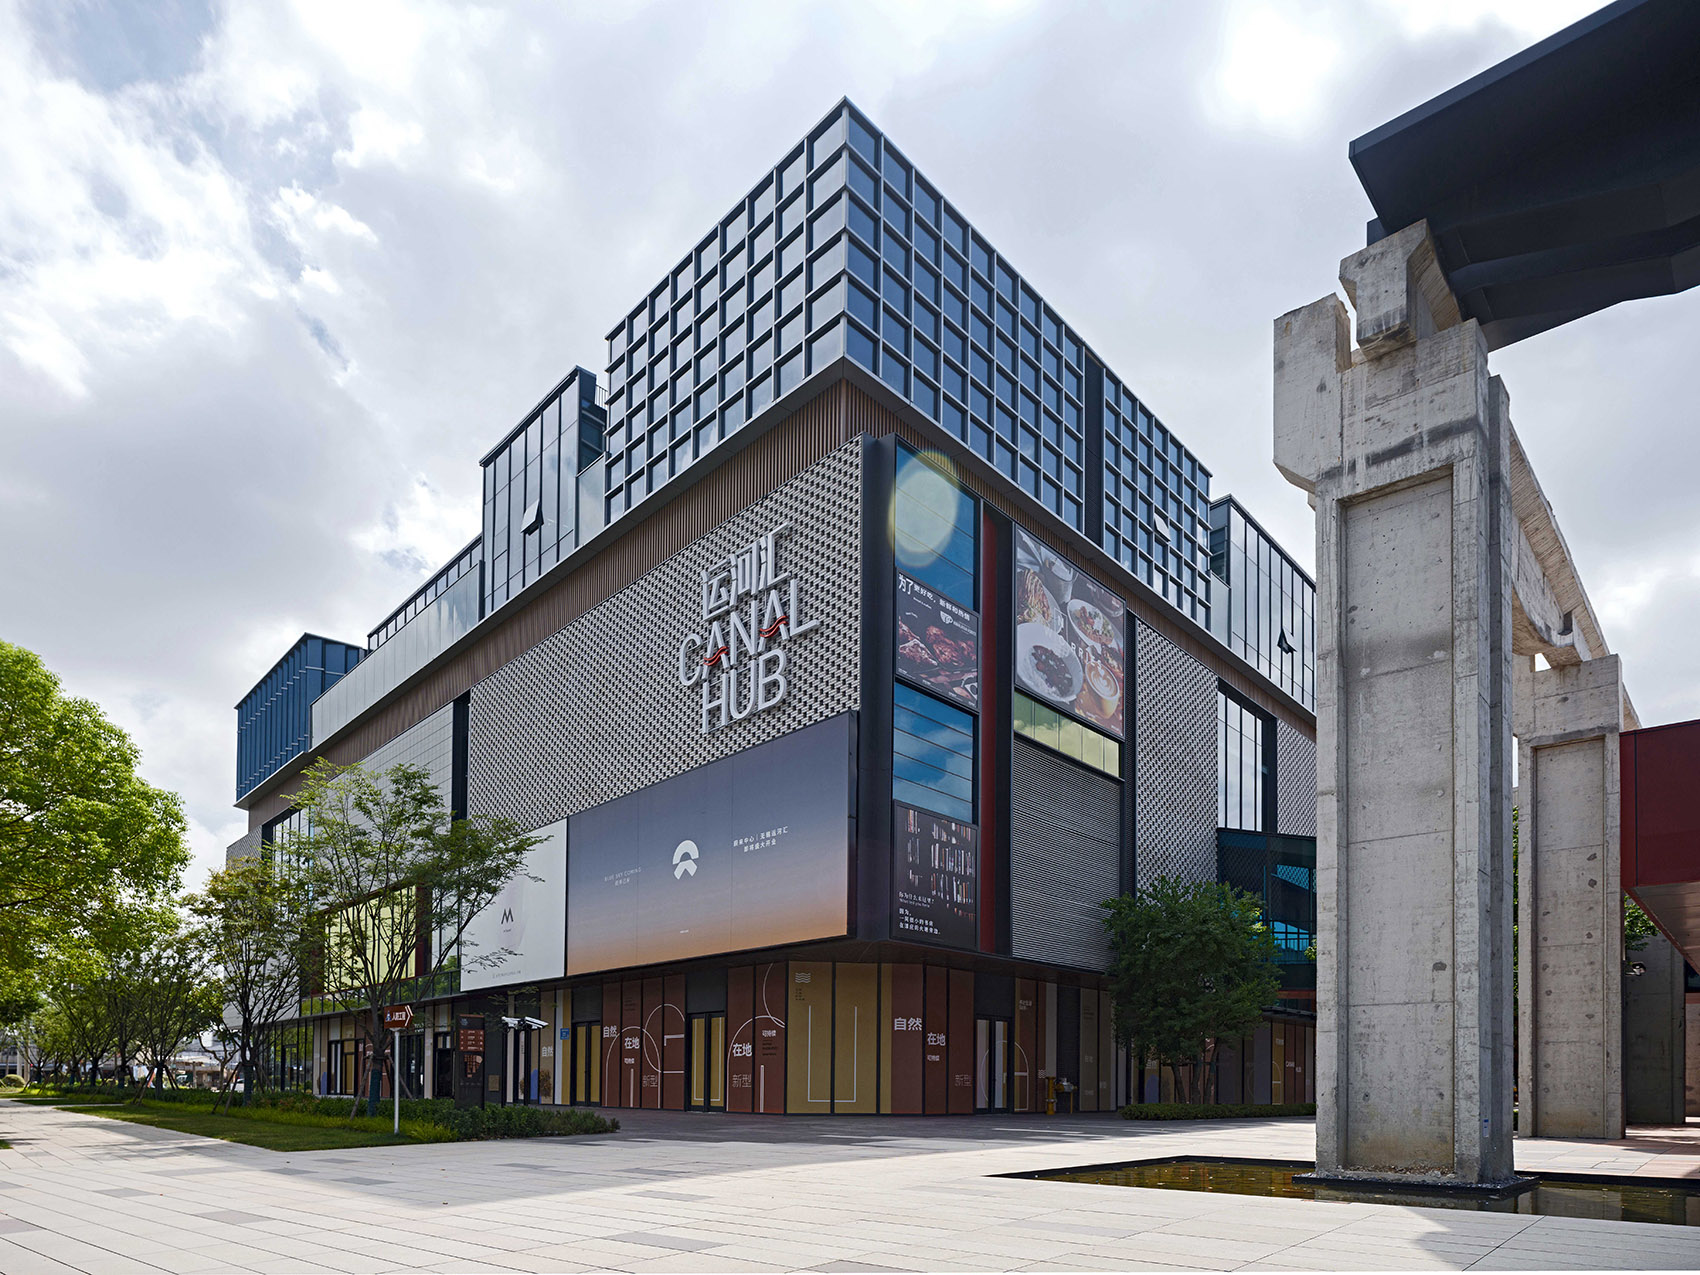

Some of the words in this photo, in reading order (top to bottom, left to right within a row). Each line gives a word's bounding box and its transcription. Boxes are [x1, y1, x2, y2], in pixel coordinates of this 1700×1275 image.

[700, 522, 792, 621] 运河汇
[679, 579, 821, 687] CANAL
[702, 649, 787, 734] HUB
[894, 1017, 922, 1031] 自然
[603, 1025, 617, 1038] 自然
[624, 1036, 640, 1049] 在地
[927, 1032, 946, 1046] 在地
[732, 1042, 752, 1057] 在地
